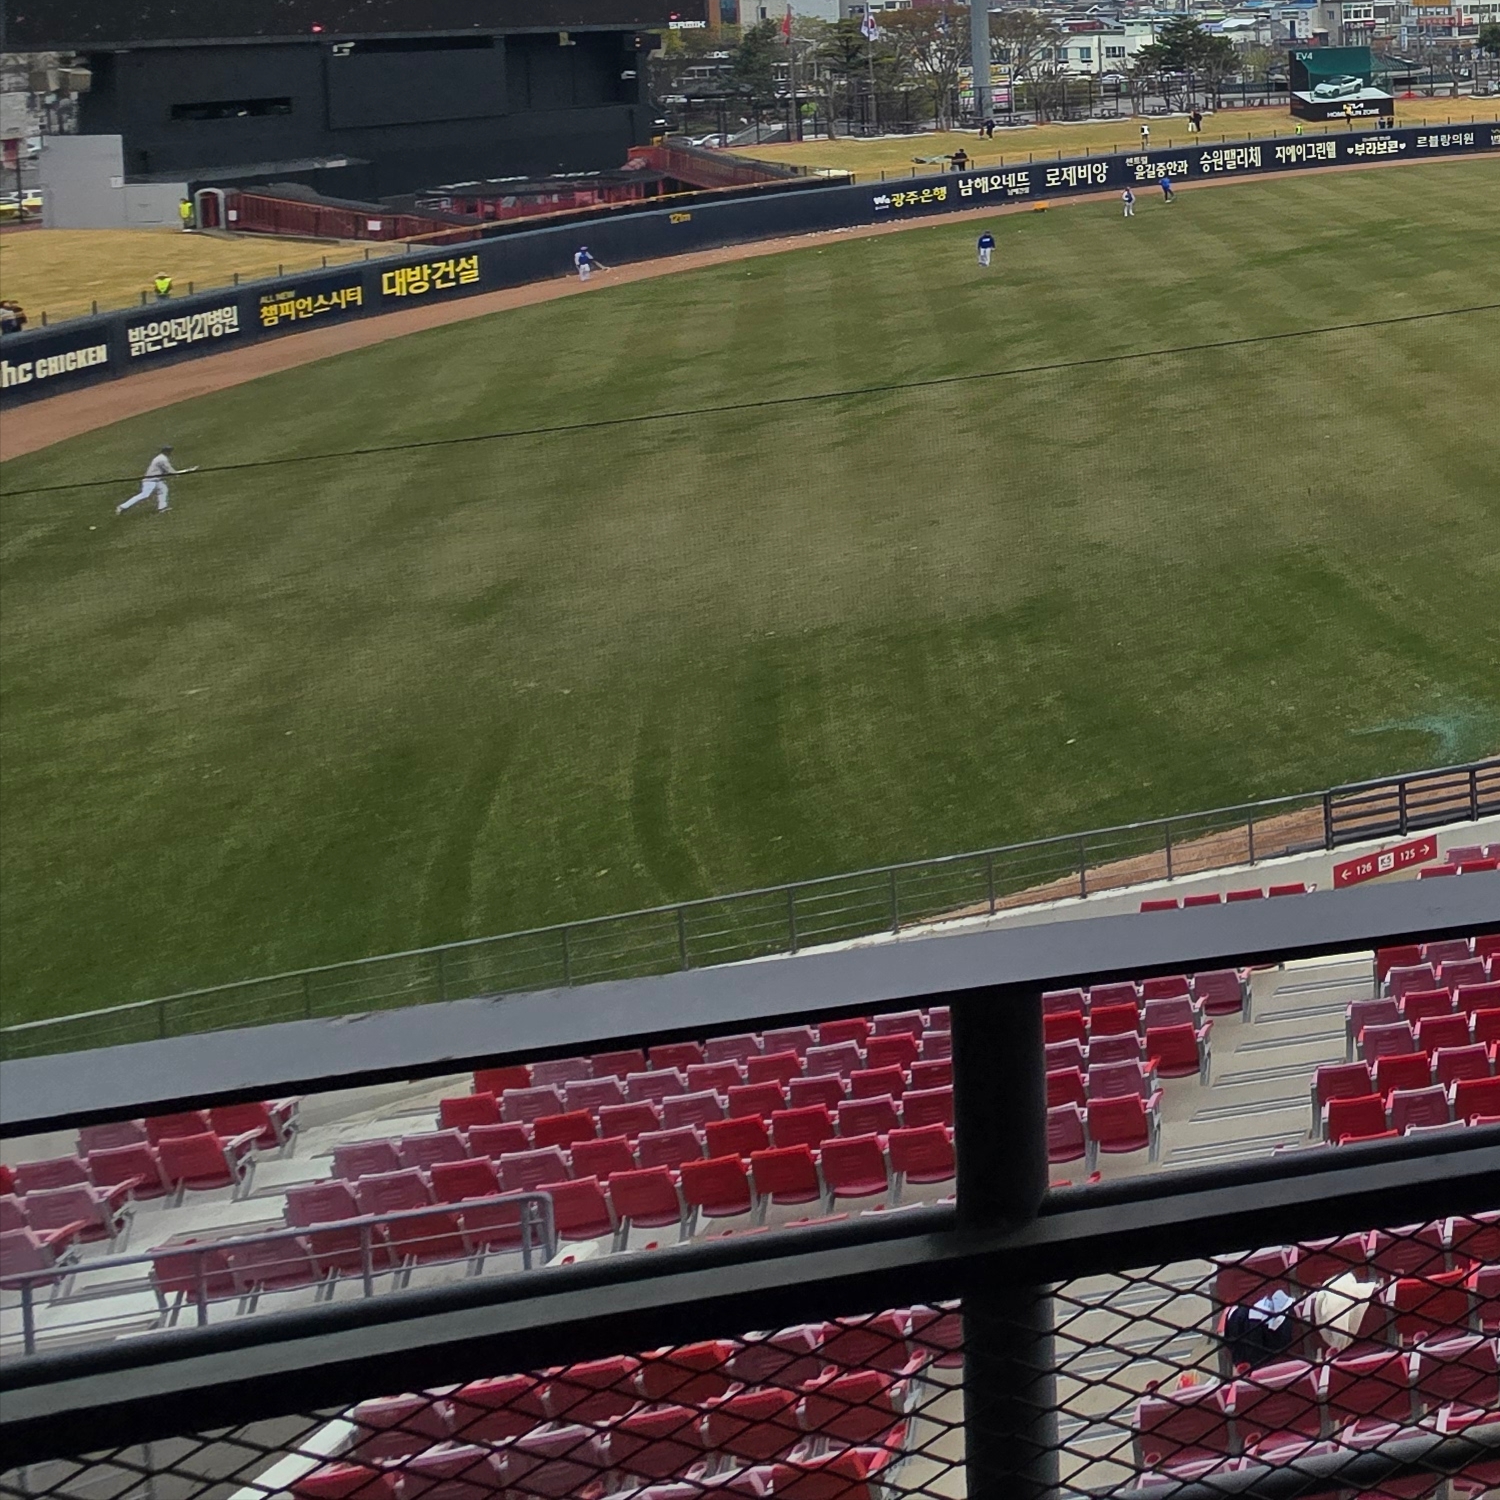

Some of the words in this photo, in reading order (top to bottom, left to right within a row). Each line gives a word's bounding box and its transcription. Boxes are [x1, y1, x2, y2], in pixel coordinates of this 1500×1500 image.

[1295, 52, 1313, 60] EV4
[1199, 146, 1262, 173] 승원팰리체
[1275, 141, 1337, 164] 지에이그린웰
[1354, 140, 1399, 156] 부라보콘
[1045, 162, 1109, 187] 로제비앙
[1134, 160, 1189, 181] 윤길중안과
[958, 171, 1032, 197] 남해오네뜨
[891, 186, 947, 208] 광주은행
[382, 255, 480, 297] 대방건설
[259, 286, 363, 327] 챔피언스시티
[128, 305, 241, 357] 밝은안과21병원
[35, 344, 108, 379] CHICKEN
[1400, 848, 1416, 862] 125
[1356, 862, 1373, 876] 126
